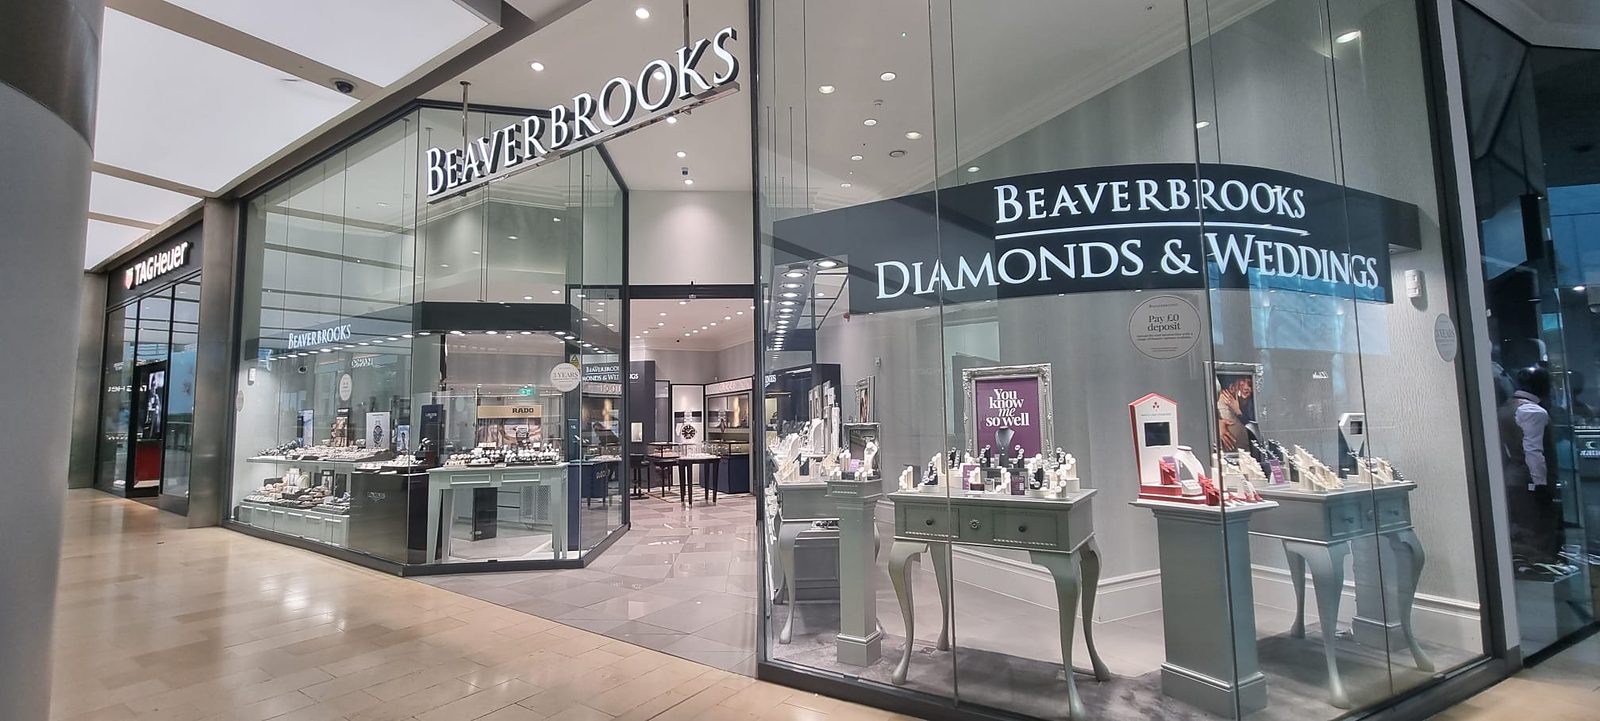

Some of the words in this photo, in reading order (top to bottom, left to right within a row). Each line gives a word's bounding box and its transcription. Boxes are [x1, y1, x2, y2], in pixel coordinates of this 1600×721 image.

[425, 26, 738, 197] BEAVERBROOKS
[993, 178, 1306, 224] BEAVERBROOKS
[874, 238, 1145, 300] DIAMONDS
[1160, 238, 1199, 275] &
[1205, 232, 1380, 291] WEDDINGS
[1148, 314, 1164, 324] Pay
[1147, 322, 1181, 332] deposit
[287, 323, 351, 349] BEAVERBROOKS
[993, 388, 1018, 400] You
[989, 396, 1025, 409] know
[998, 407, 1016, 417] me
[985, 416, 1001, 427] so
[1002, 412, 1030, 427] well
